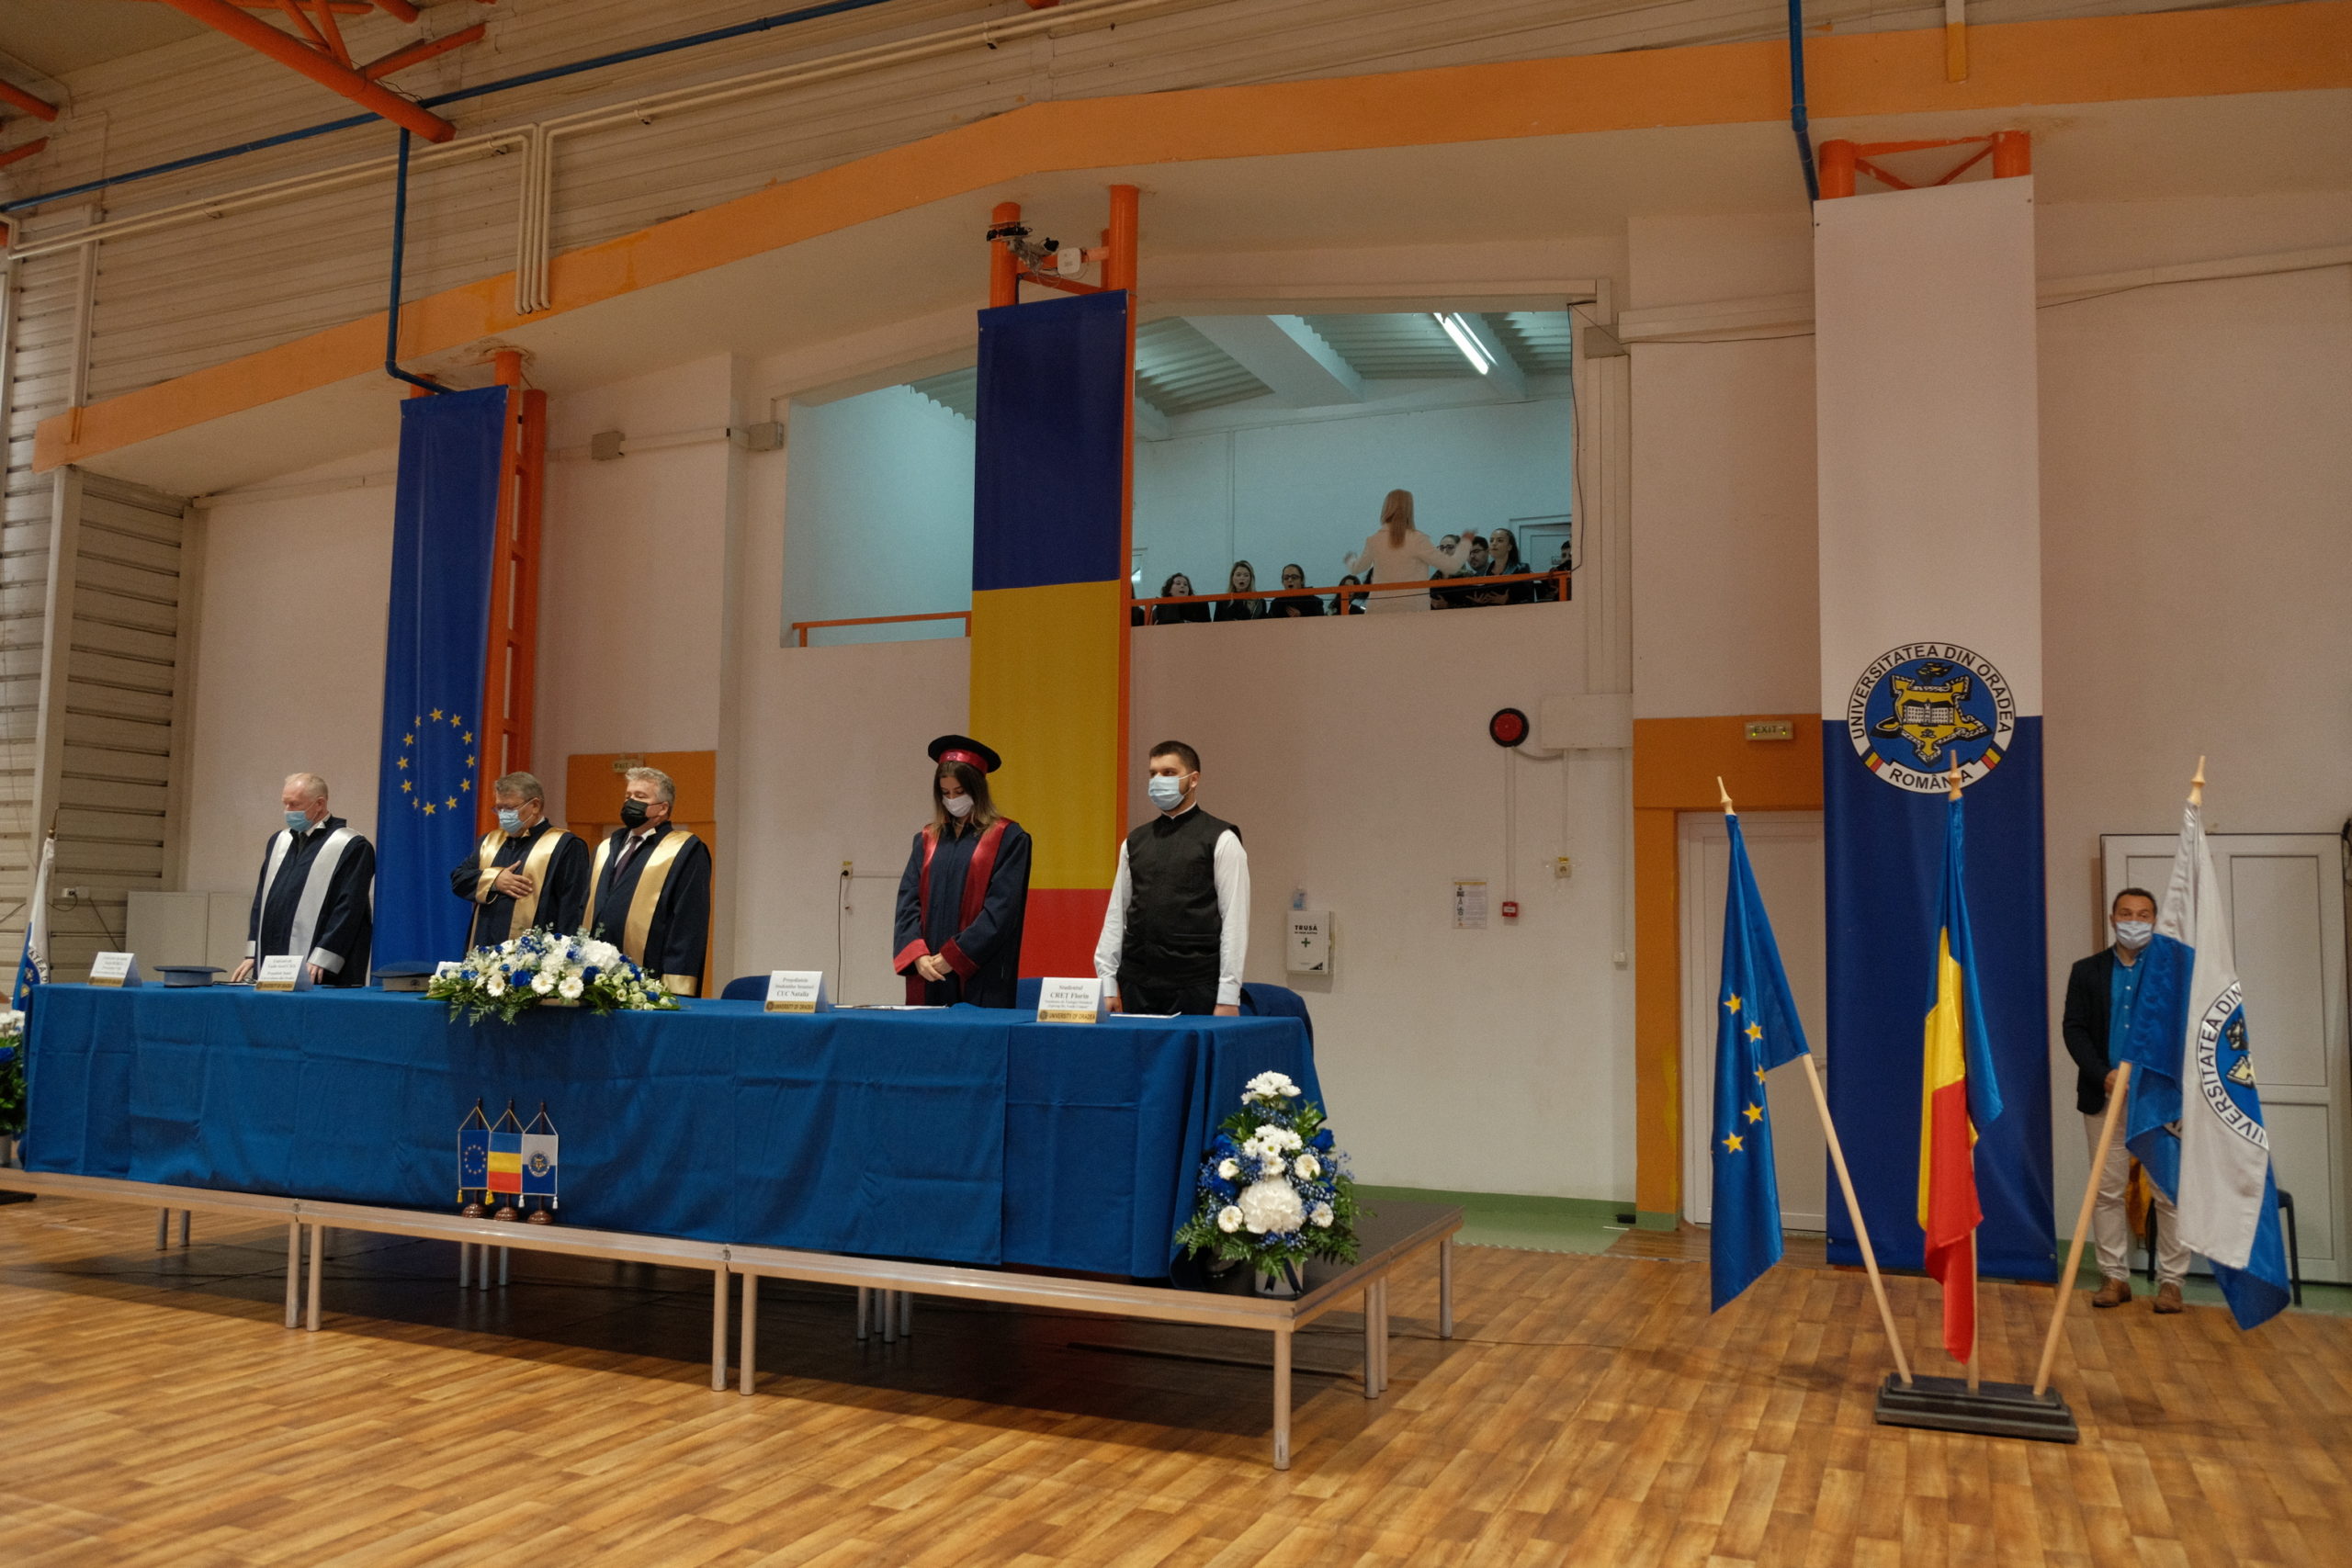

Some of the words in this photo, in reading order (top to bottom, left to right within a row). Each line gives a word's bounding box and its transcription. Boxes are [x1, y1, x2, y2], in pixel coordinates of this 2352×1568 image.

[1850, 645, 1939, 739] UNIVERSITATEA
[1944, 645, 1976, 667] DIN
[1976, 663, 2014, 734] ORADEA
[1889, 768, 1973, 790] ROMÂNA
